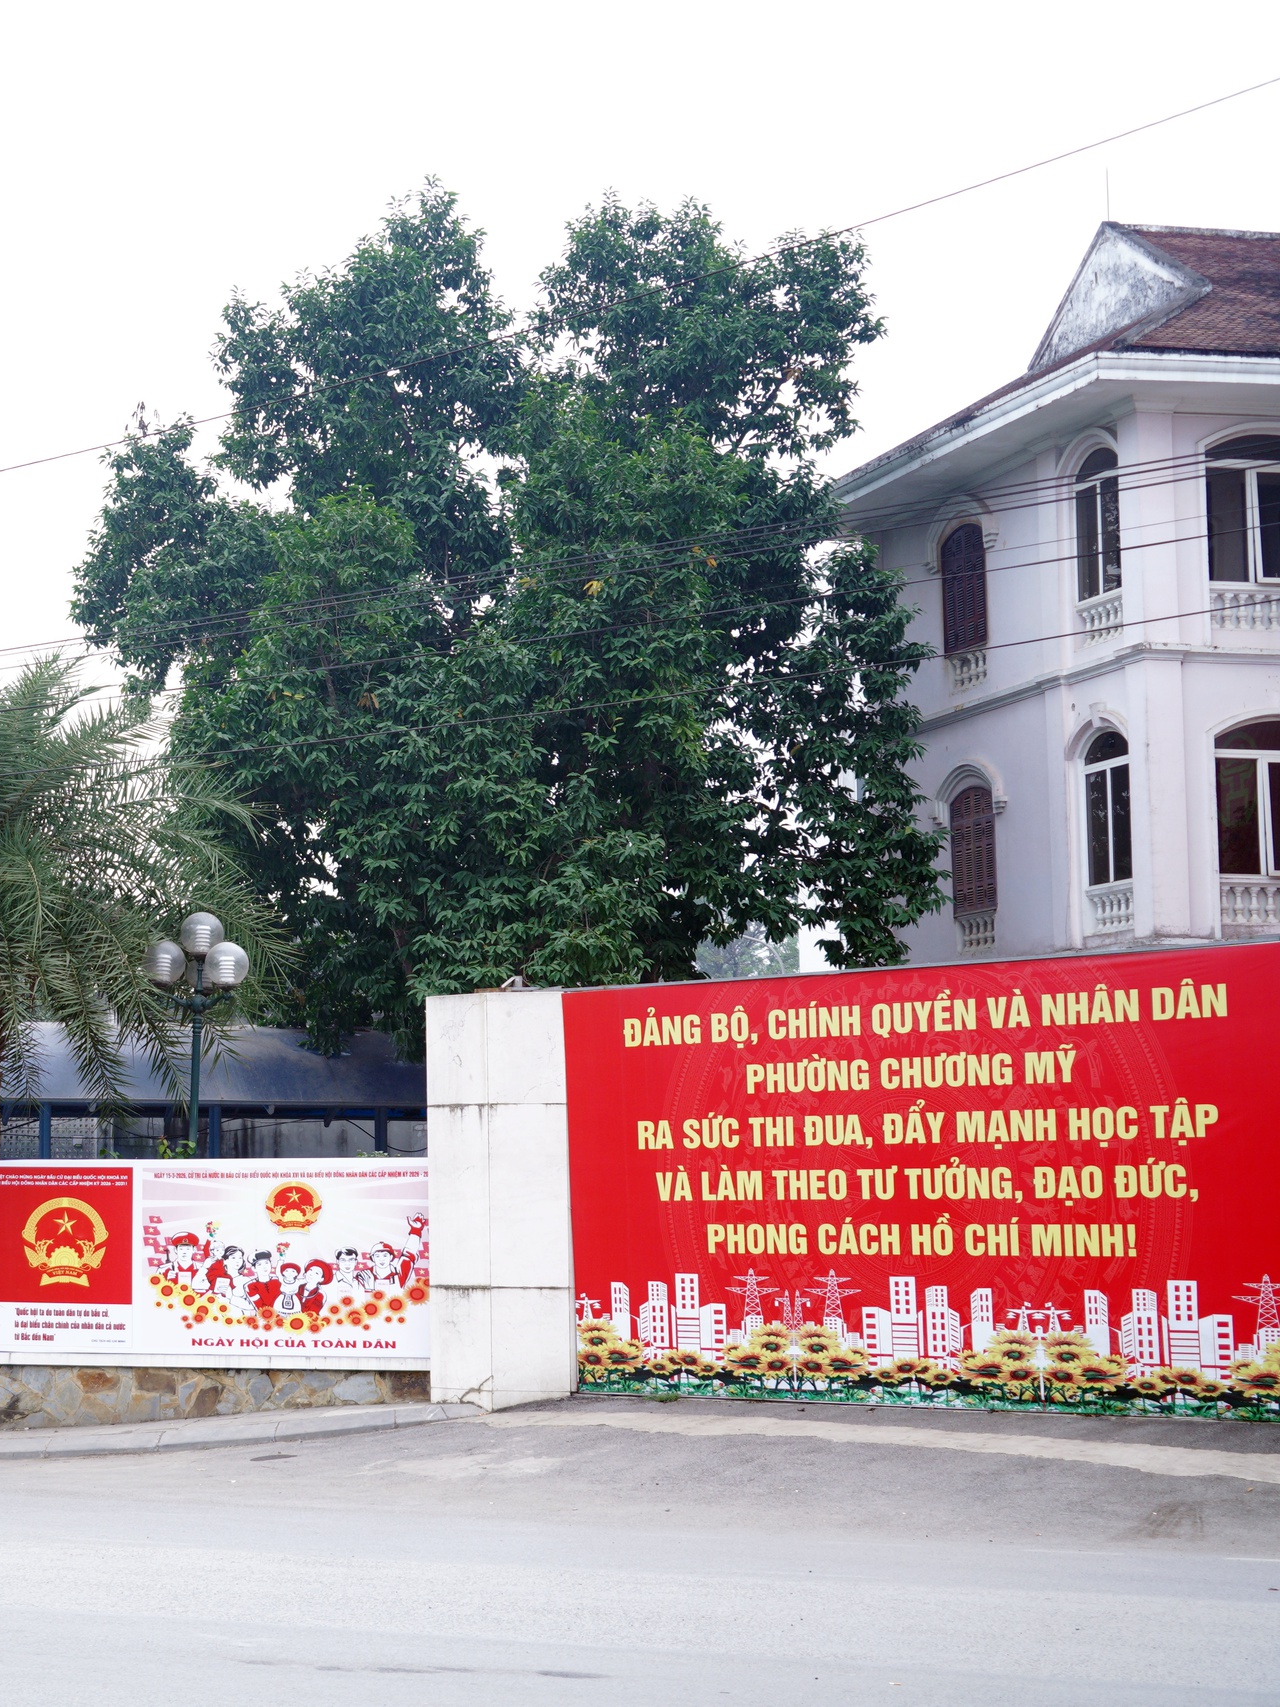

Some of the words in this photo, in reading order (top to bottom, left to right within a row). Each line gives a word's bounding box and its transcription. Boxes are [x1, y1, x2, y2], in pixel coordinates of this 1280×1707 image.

[623, 1007, 701, 1047] ĐẢNG
[710, 1005, 758, 1048] BỘ,
[768, 1001, 861, 1040] CHÍNH
[871, 990, 977, 1039] QUYỀN
[986, 989, 1030, 1029] VÀ
[1042, 984, 1139, 1026] NHÂN
[1152, 978, 1228, 1021] DÂN
[746, 1053, 869, 1094] PHƯỜNG
[880, 1052, 1013, 1089] CHƯƠNG
[1024, 1044, 1076, 1085] MỸ
[637, 1120, 674, 1150] RA
[683, 1112, 739, 1149] SỨC
[749, 1116, 794, 1147] THI
[803, 1114, 873, 1149] ĐUA,
[882, 1099, 944, 1144] ĐẨY
[956, 1109, 1057, 1150] MẠNH
[1069, 1106, 1138, 1147] HỌC
[1150, 1097, 1219, 1146] TẬP
[655, 1165, 693, 1201] VÀ
[701, 1164, 763, 1201] LÀM
[771, 1169, 847, 1200] THEO
[857, 1165, 897, 1200] TƯ
[904, 1156, 1023, 1203] TƯỞNG,
[1033, 1165, 1103, 1206] ĐẠO
[1114, 1157, 1199, 1202] ĐỨC,
[707, 1223, 808, 1255] PHONG
[817, 1217, 900, 1255] CÁCH
[911, 1213, 954, 1256] HỒ
[964, 1217, 1019, 1256] CHÍ
[1031, 1224, 1137, 1257] MINH!
[191, 1336, 235, 1347] NGÀY
[239, 1336, 269, 1349] HỘI
[274, 1336, 307, 1348] CỦA
[311, 1337, 357, 1349] TOÀN
[362, 1339, 397, 1349] DÂN
